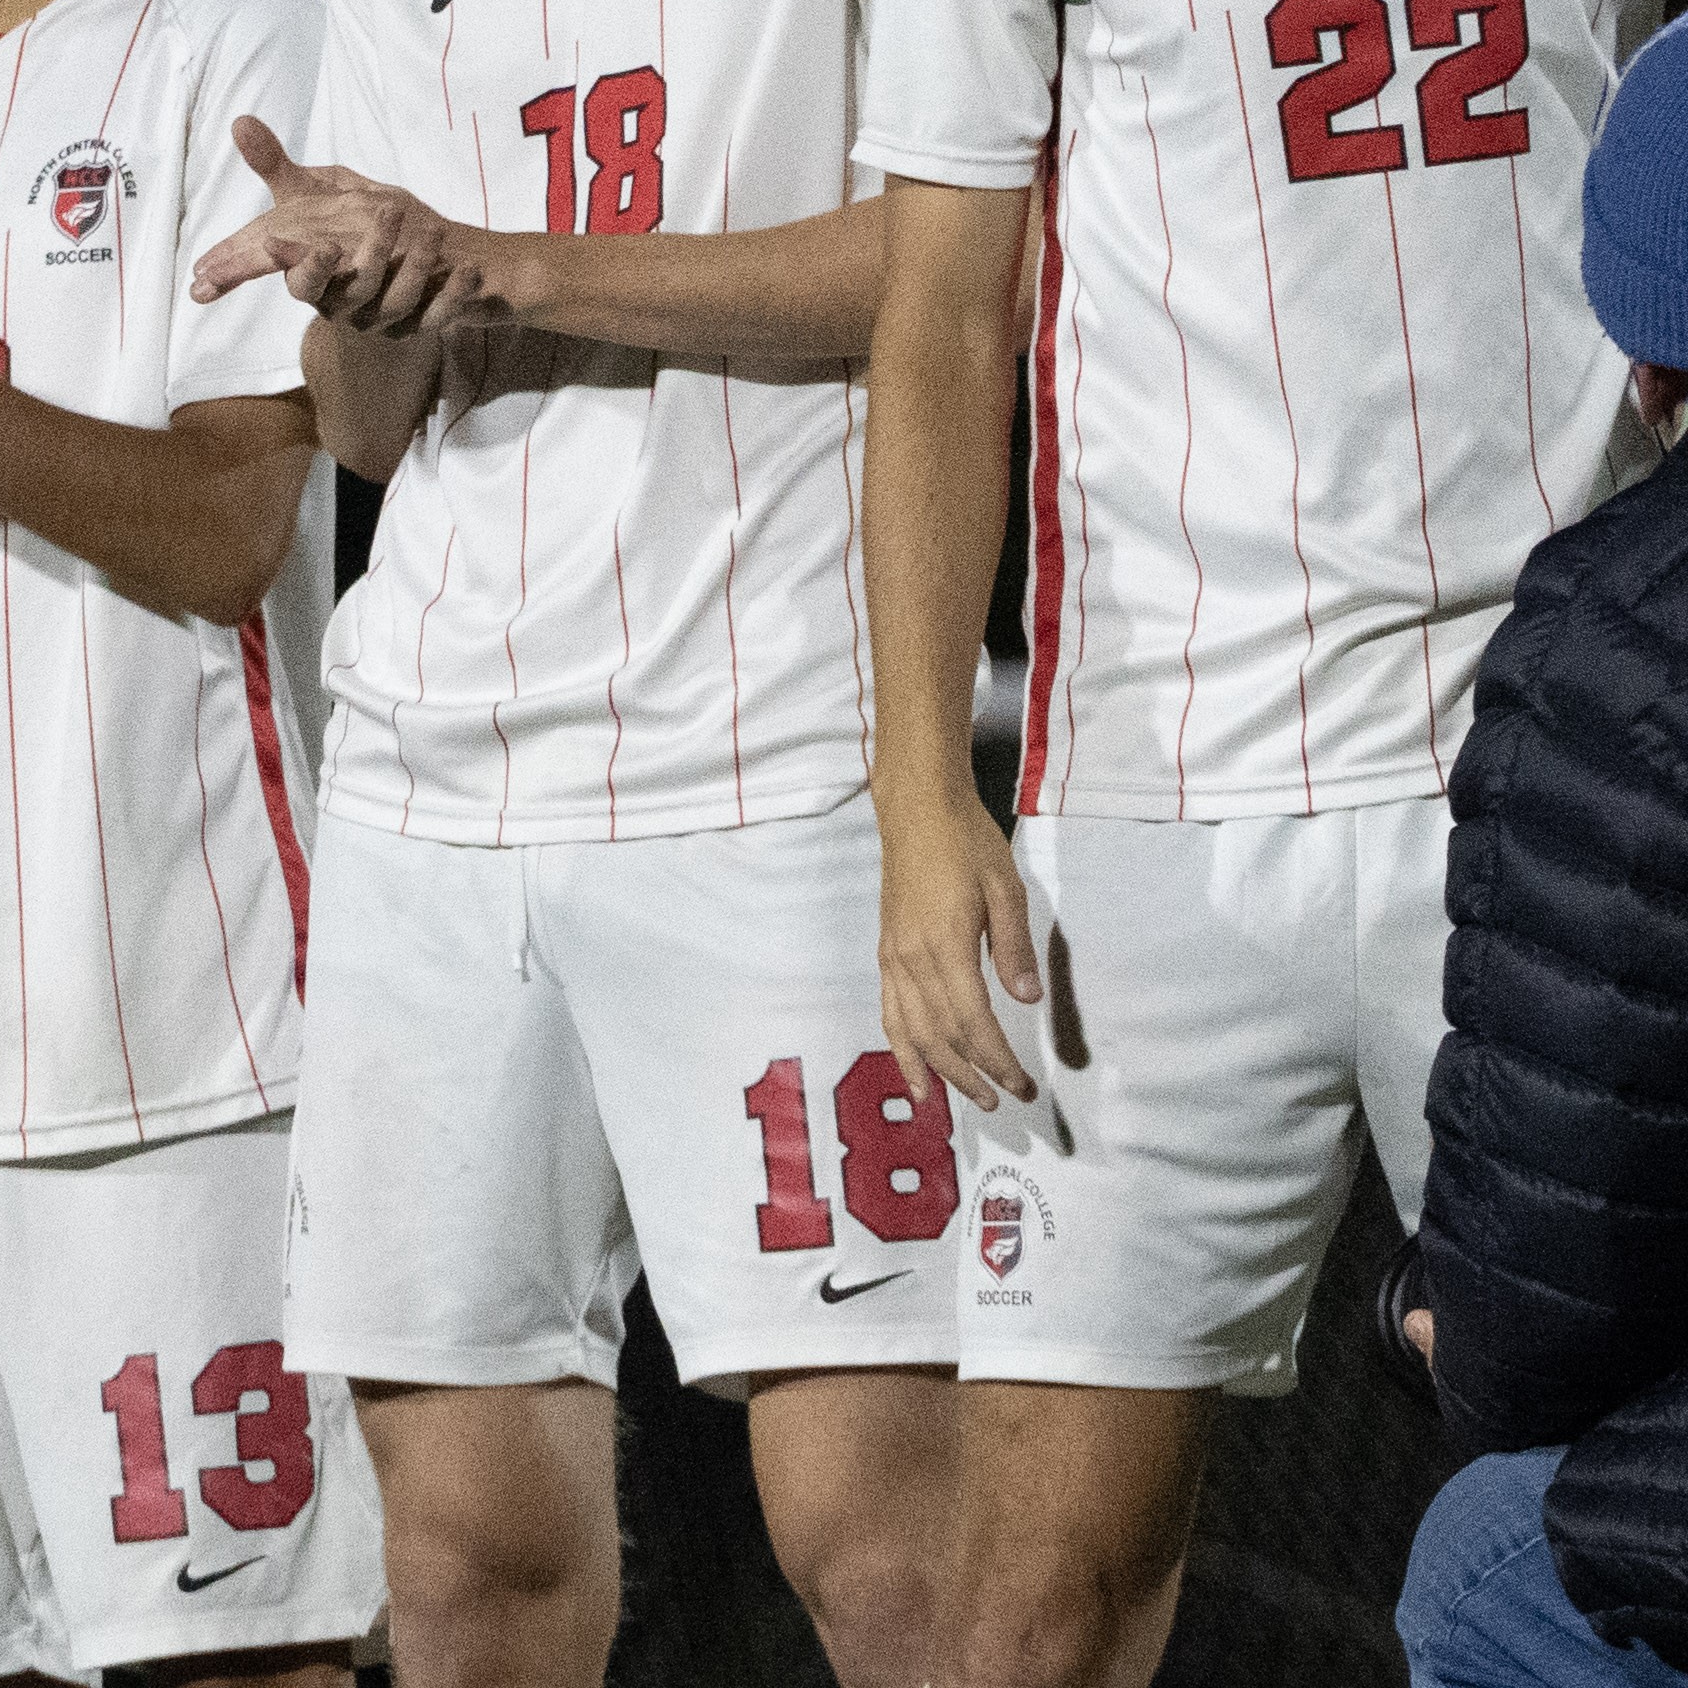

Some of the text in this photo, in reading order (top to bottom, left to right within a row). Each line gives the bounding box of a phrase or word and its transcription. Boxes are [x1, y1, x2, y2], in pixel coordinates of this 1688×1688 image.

[27, 158, 58, 205] NORTH
[520, 65, 667, 235] 18
[45, 248, 113, 266] SOCCER
[744, 1050, 960, 1253] 18
[1024, 1177, 1056, 1242] COLLEGE
[976, 1289, 1033, 1306] SOCCER
[101, 1339, 315, 1546] 13
